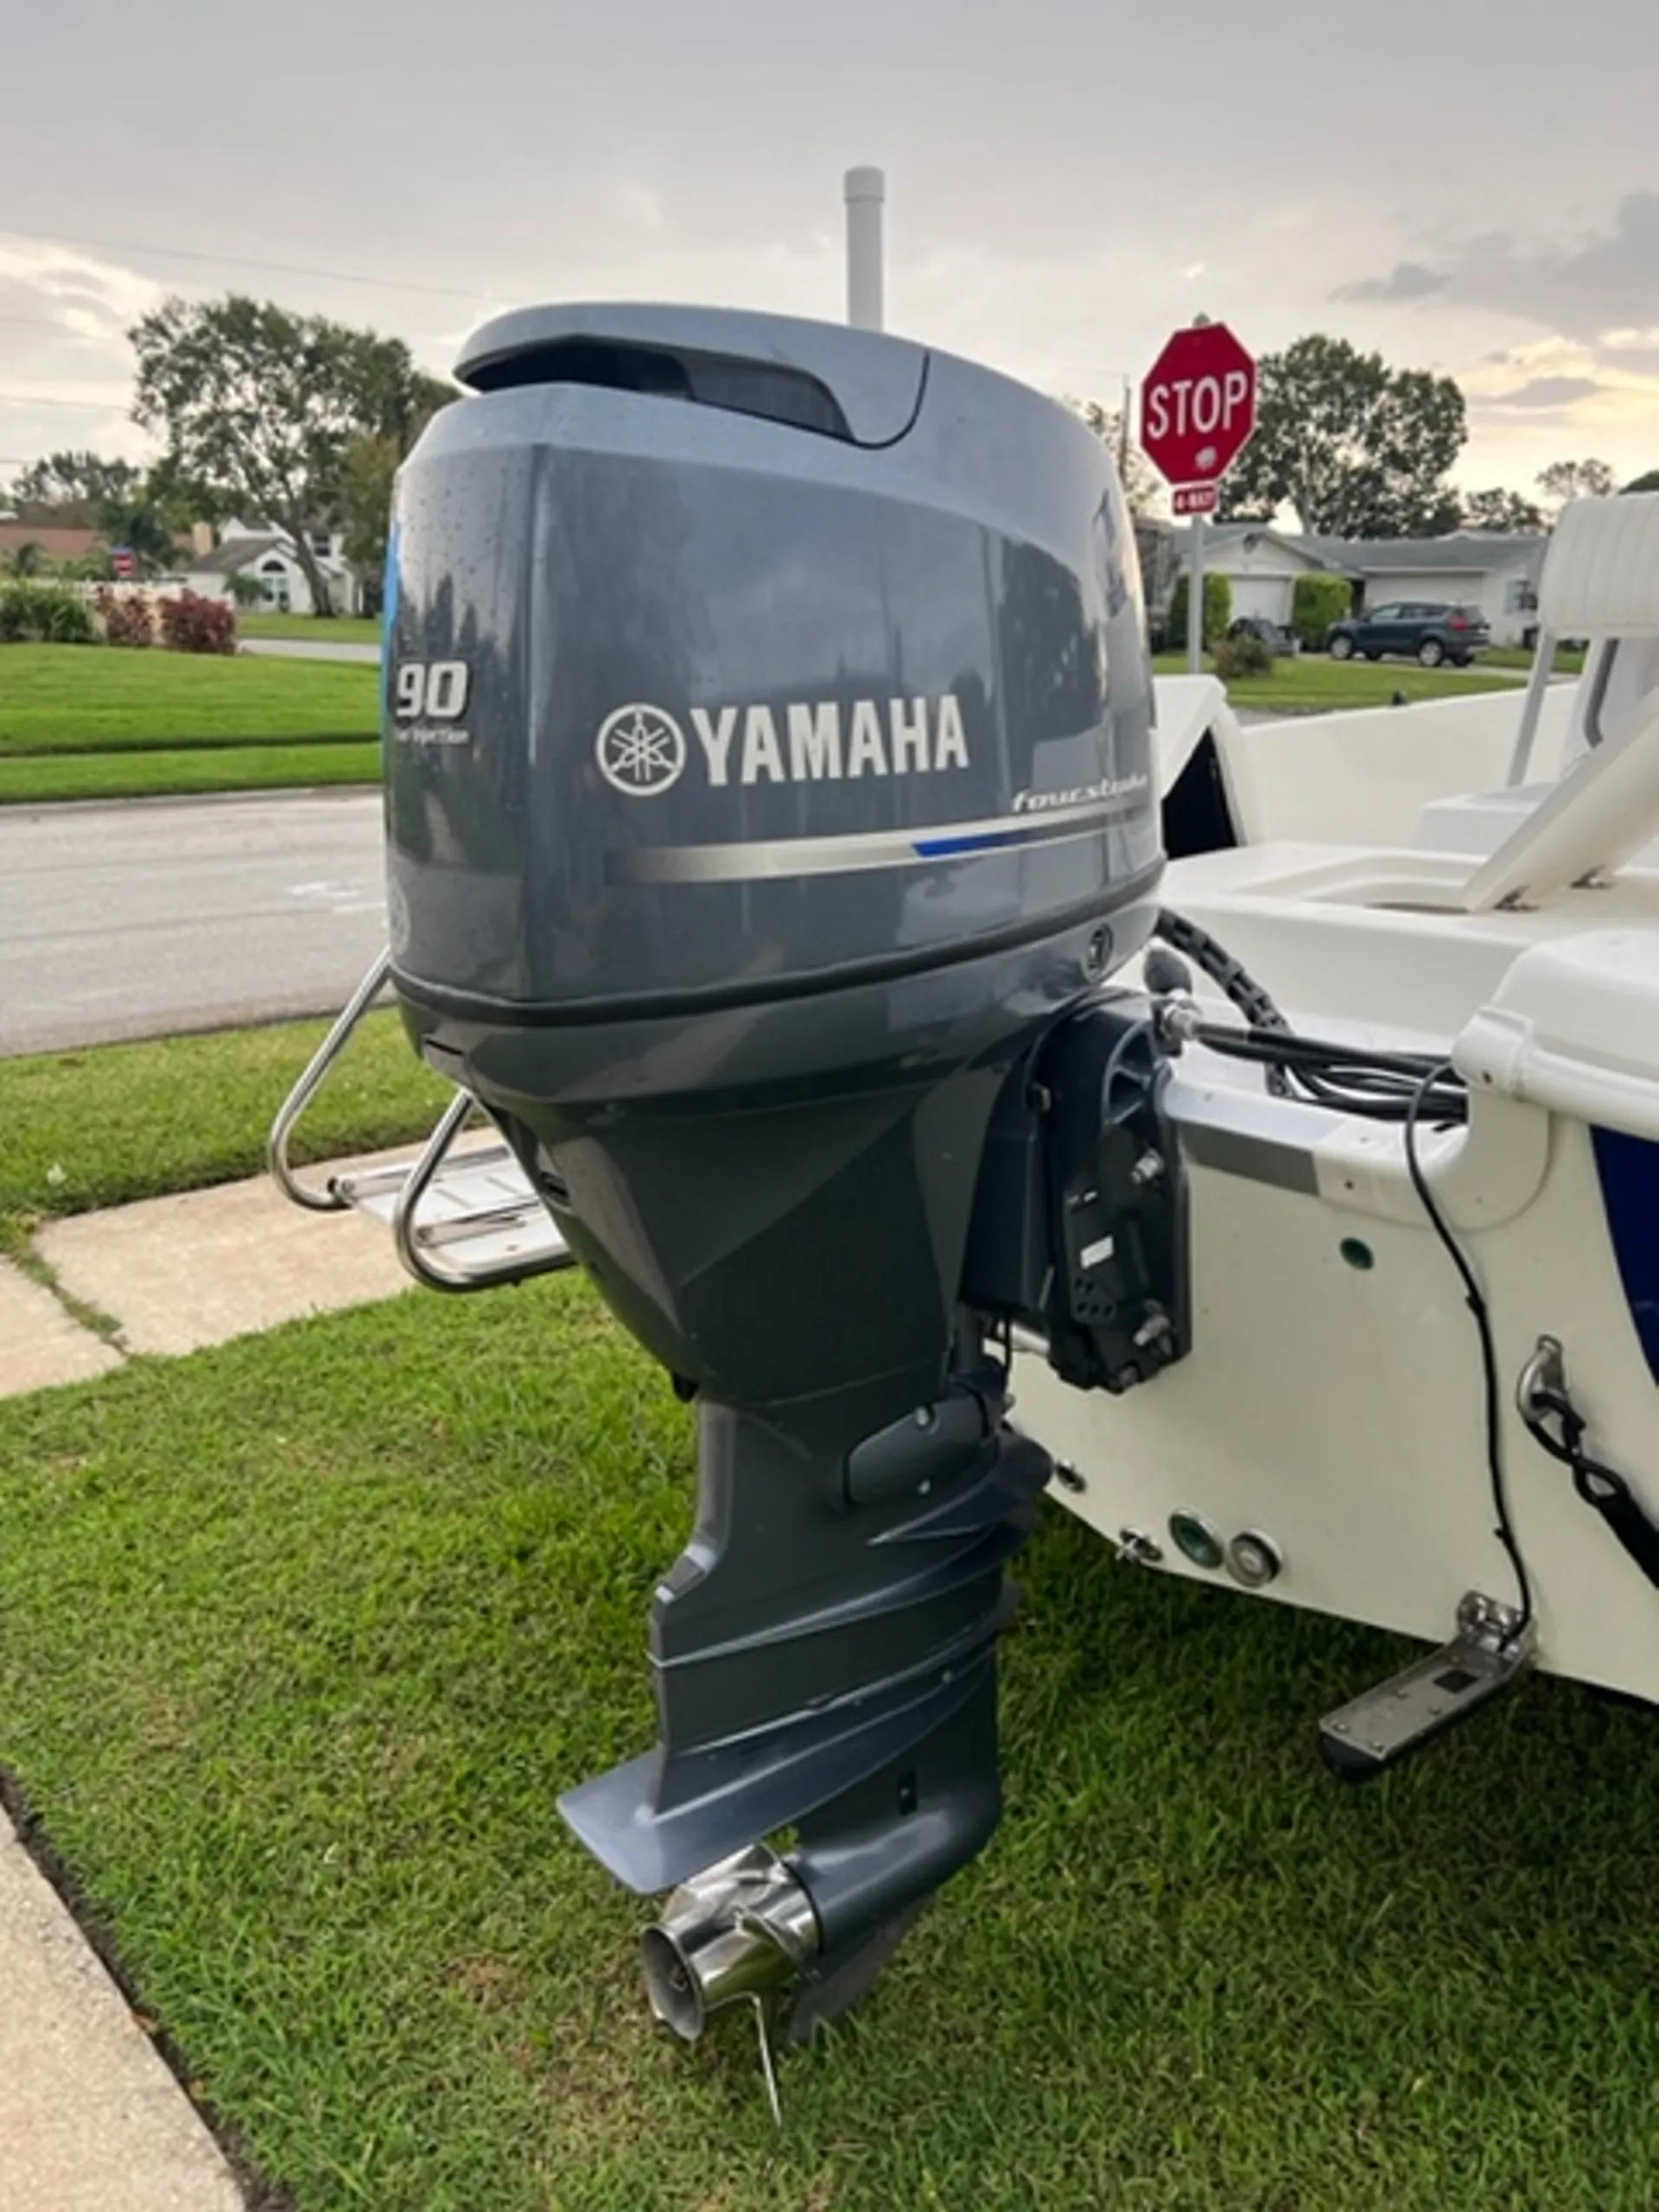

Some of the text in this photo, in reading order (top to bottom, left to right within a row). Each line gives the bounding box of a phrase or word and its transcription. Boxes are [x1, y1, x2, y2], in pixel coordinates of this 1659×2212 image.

[1147, 371, 1248, 441] STOP
[396, 661, 467, 718] 90
[690, 694, 969, 787] YAMAHA
